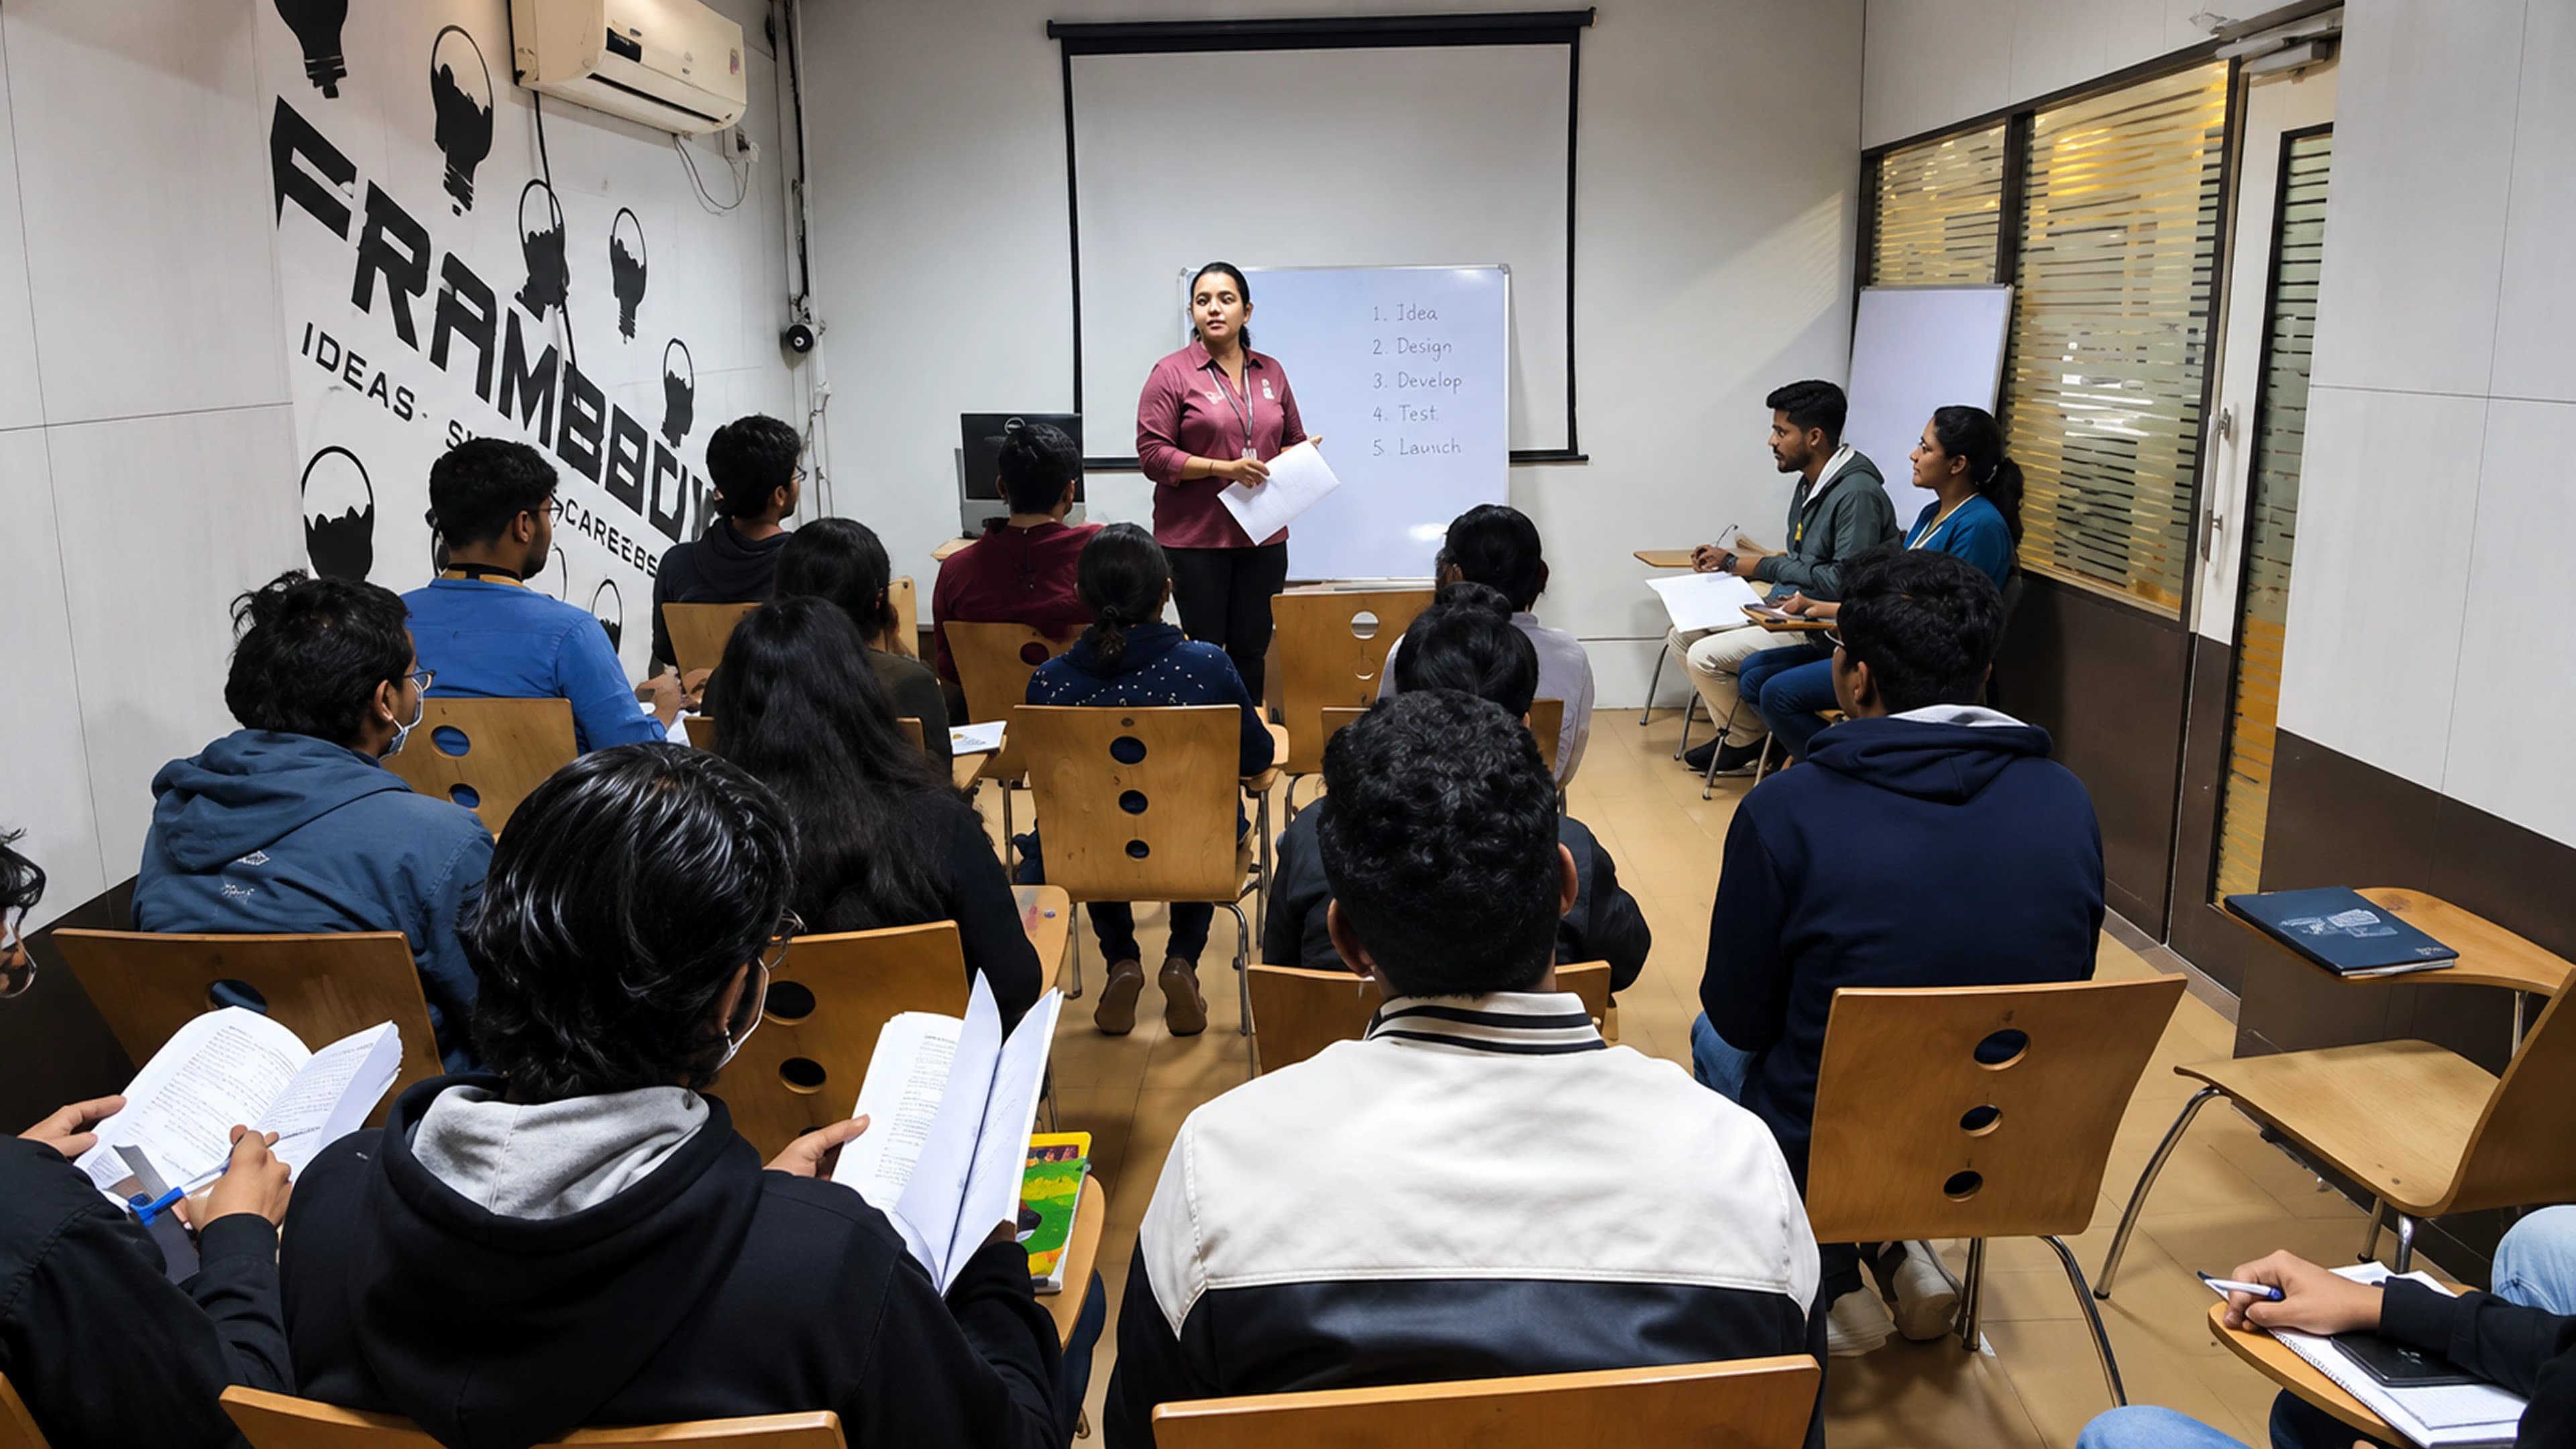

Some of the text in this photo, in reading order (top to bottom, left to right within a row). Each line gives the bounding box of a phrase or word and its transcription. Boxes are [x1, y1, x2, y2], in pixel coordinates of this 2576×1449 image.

[1373, 303, 1438, 321] 1. Idea
[1372, 337, 1452, 363] 2. Design
[1373, 371, 1462, 394] 3. Develop
[1373, 407, 1389, 422] 4.
